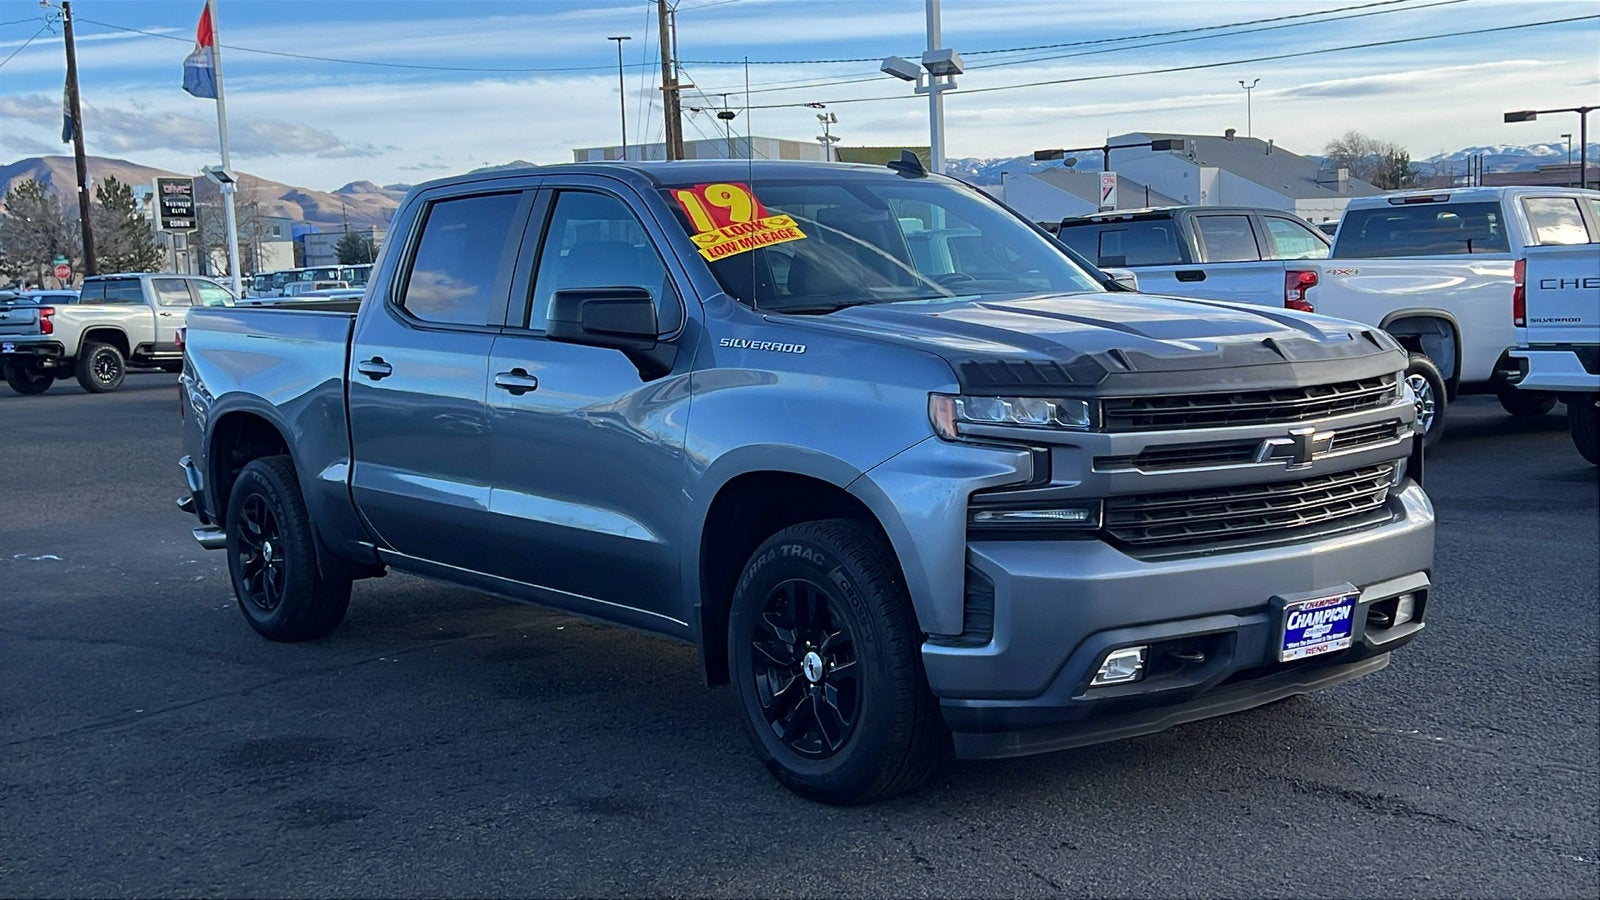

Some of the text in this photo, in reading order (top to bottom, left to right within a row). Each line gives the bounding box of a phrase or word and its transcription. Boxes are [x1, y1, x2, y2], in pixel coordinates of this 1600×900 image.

[162, 183, 191, 194] GMC
[677, 183, 757, 232] 19
[720, 219, 766, 239] LOOK
[705, 227, 798, 259] LOW MILEAGE
[719, 337, 807, 354] SILVERADO
[780, 543, 826, 566] TRAC
[1305, 597, 1339, 609] CHAMPION
[1287, 605, 1351, 630] CHAMPION
[1305, 644, 1328, 655] RENO
